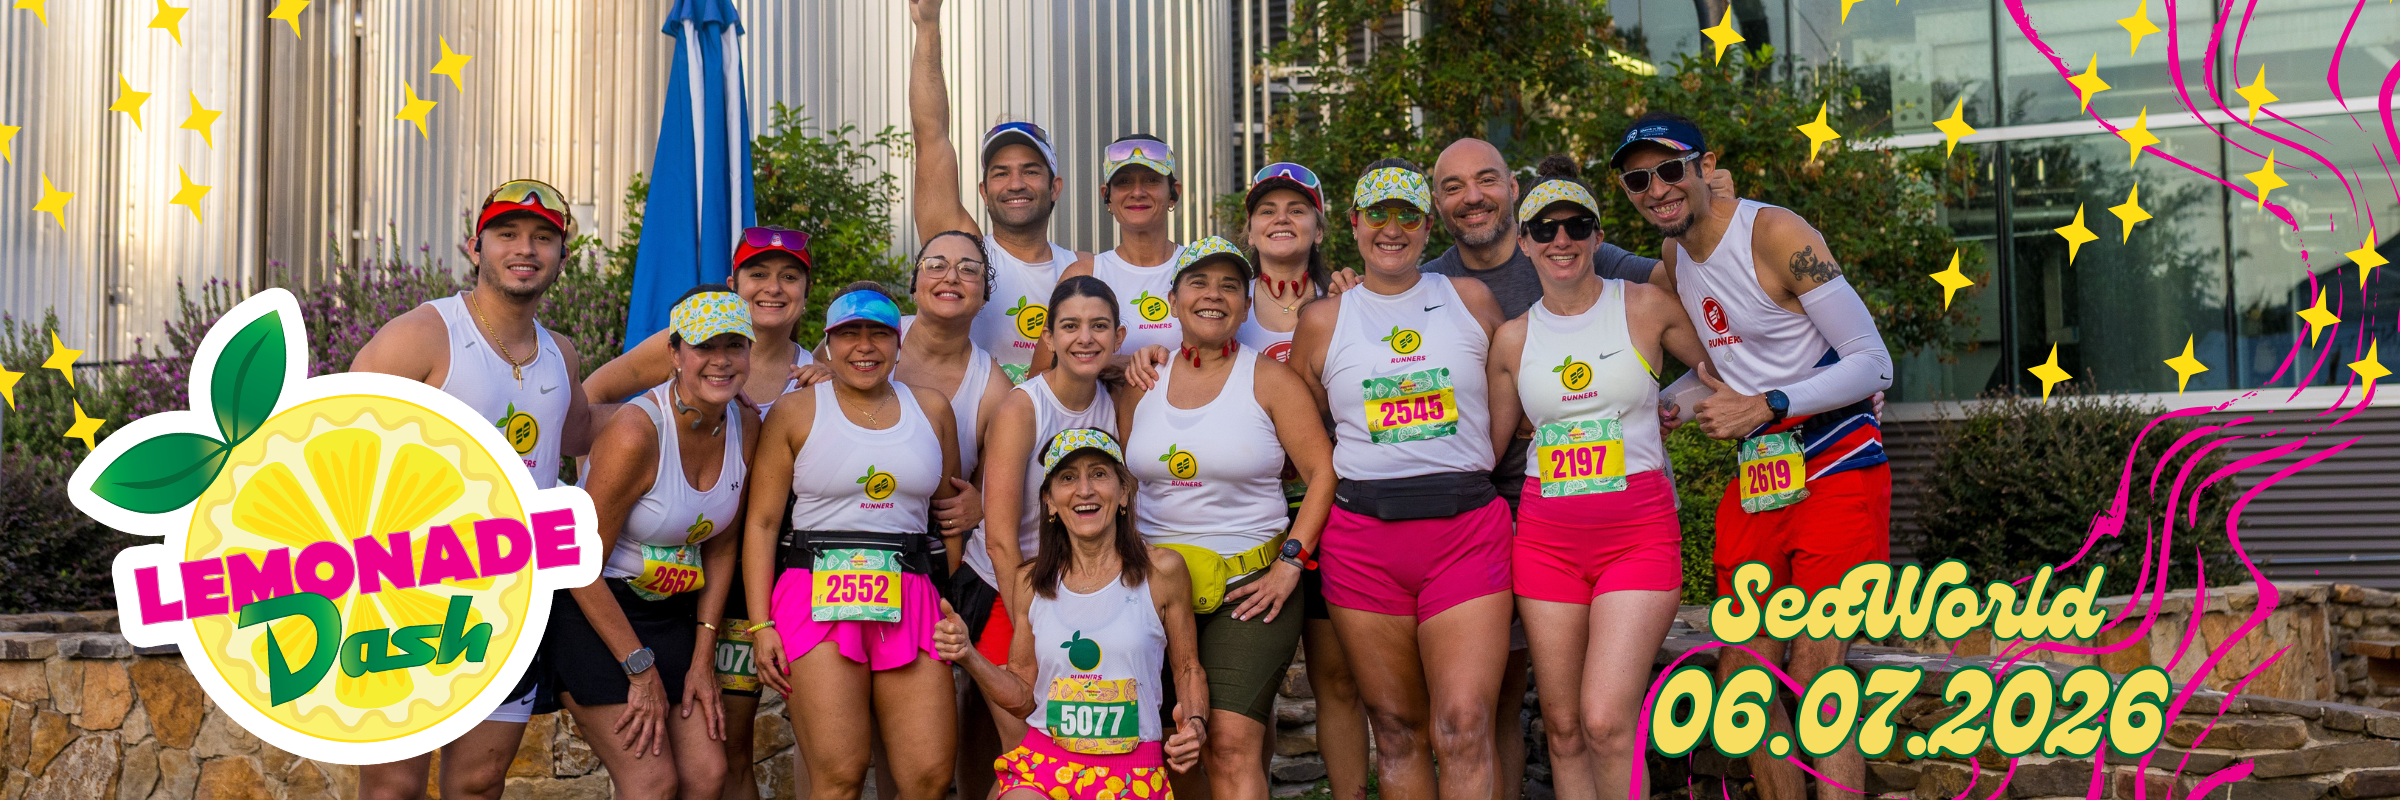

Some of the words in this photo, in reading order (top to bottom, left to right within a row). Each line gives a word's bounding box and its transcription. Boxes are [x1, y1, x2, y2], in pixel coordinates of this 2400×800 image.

[1138, 322, 1173, 330] RUNNERS
[1012, 340, 1037, 351] RUNN
[1708, 335, 1744, 348] RUNNERS
[1390, 355, 1426, 364] RUNNERS
[1561, 390, 1599, 402] RUNNERS
[1380, 393, 1445, 428] 2545
[1551, 445, 1607, 479] 2197
[1170, 479, 1203, 488] RUNNERS
[1748, 459, 1791, 495] 2619
[859, 502, 894, 510] RUNNERS
[646, 565, 698, 595] 2667
[826, 573, 889, 604] 2552
[714, 641, 758, 675] 078
[1060, 704, 1125, 737] 5077
